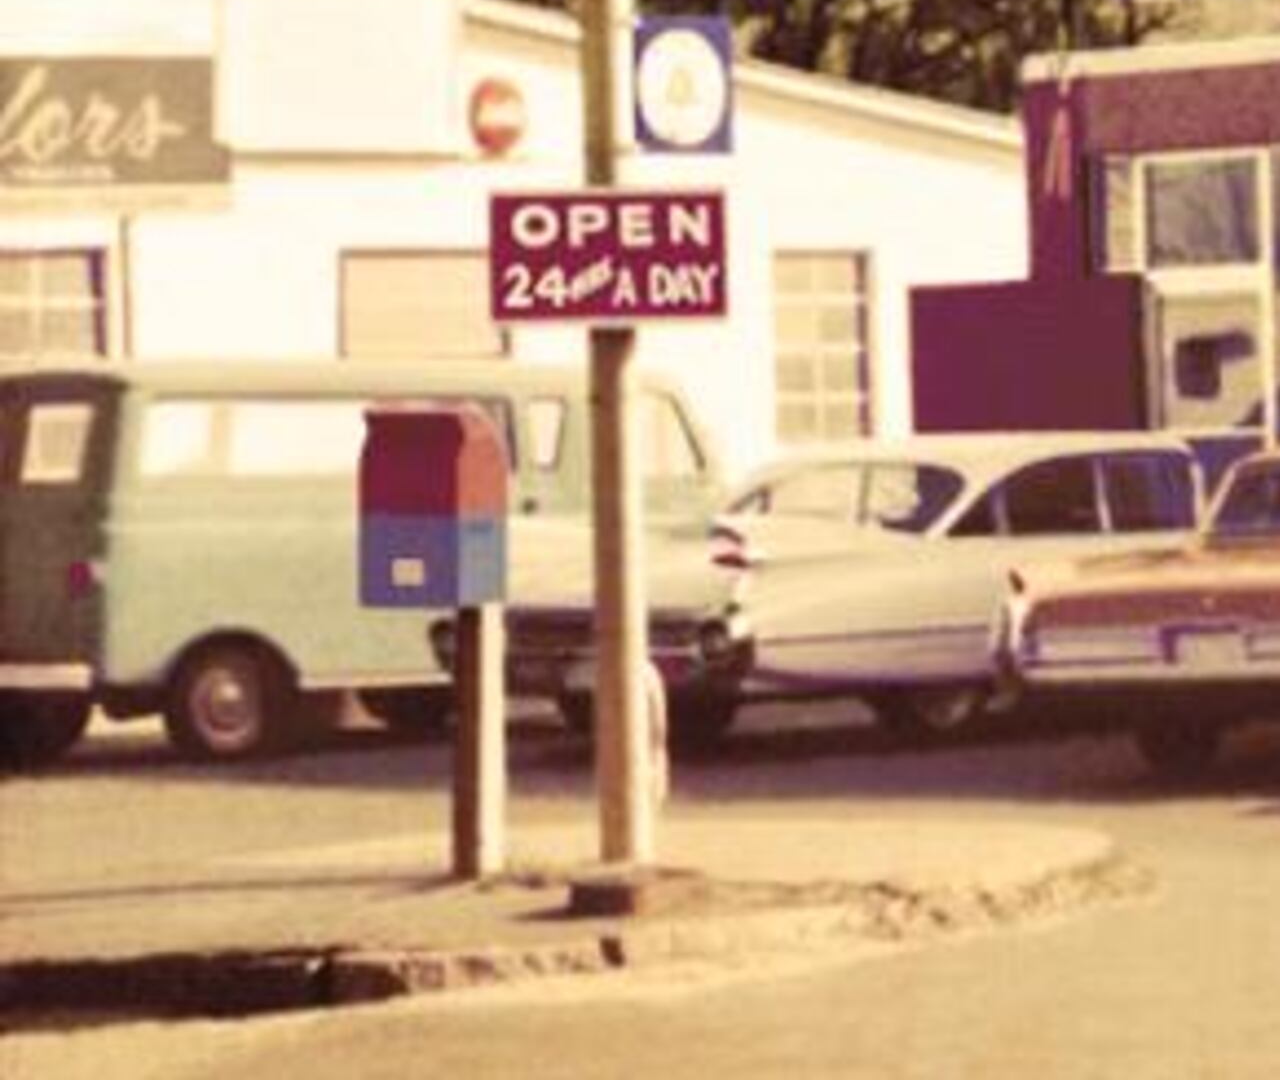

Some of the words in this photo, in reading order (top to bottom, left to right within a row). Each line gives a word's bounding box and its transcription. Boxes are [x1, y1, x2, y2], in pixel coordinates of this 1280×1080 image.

[511, 204, 711, 248] OPEN
[504, 263, 567, 308] 24
[612, 267, 637, 306] A
[651, 264, 718, 305] DAY
